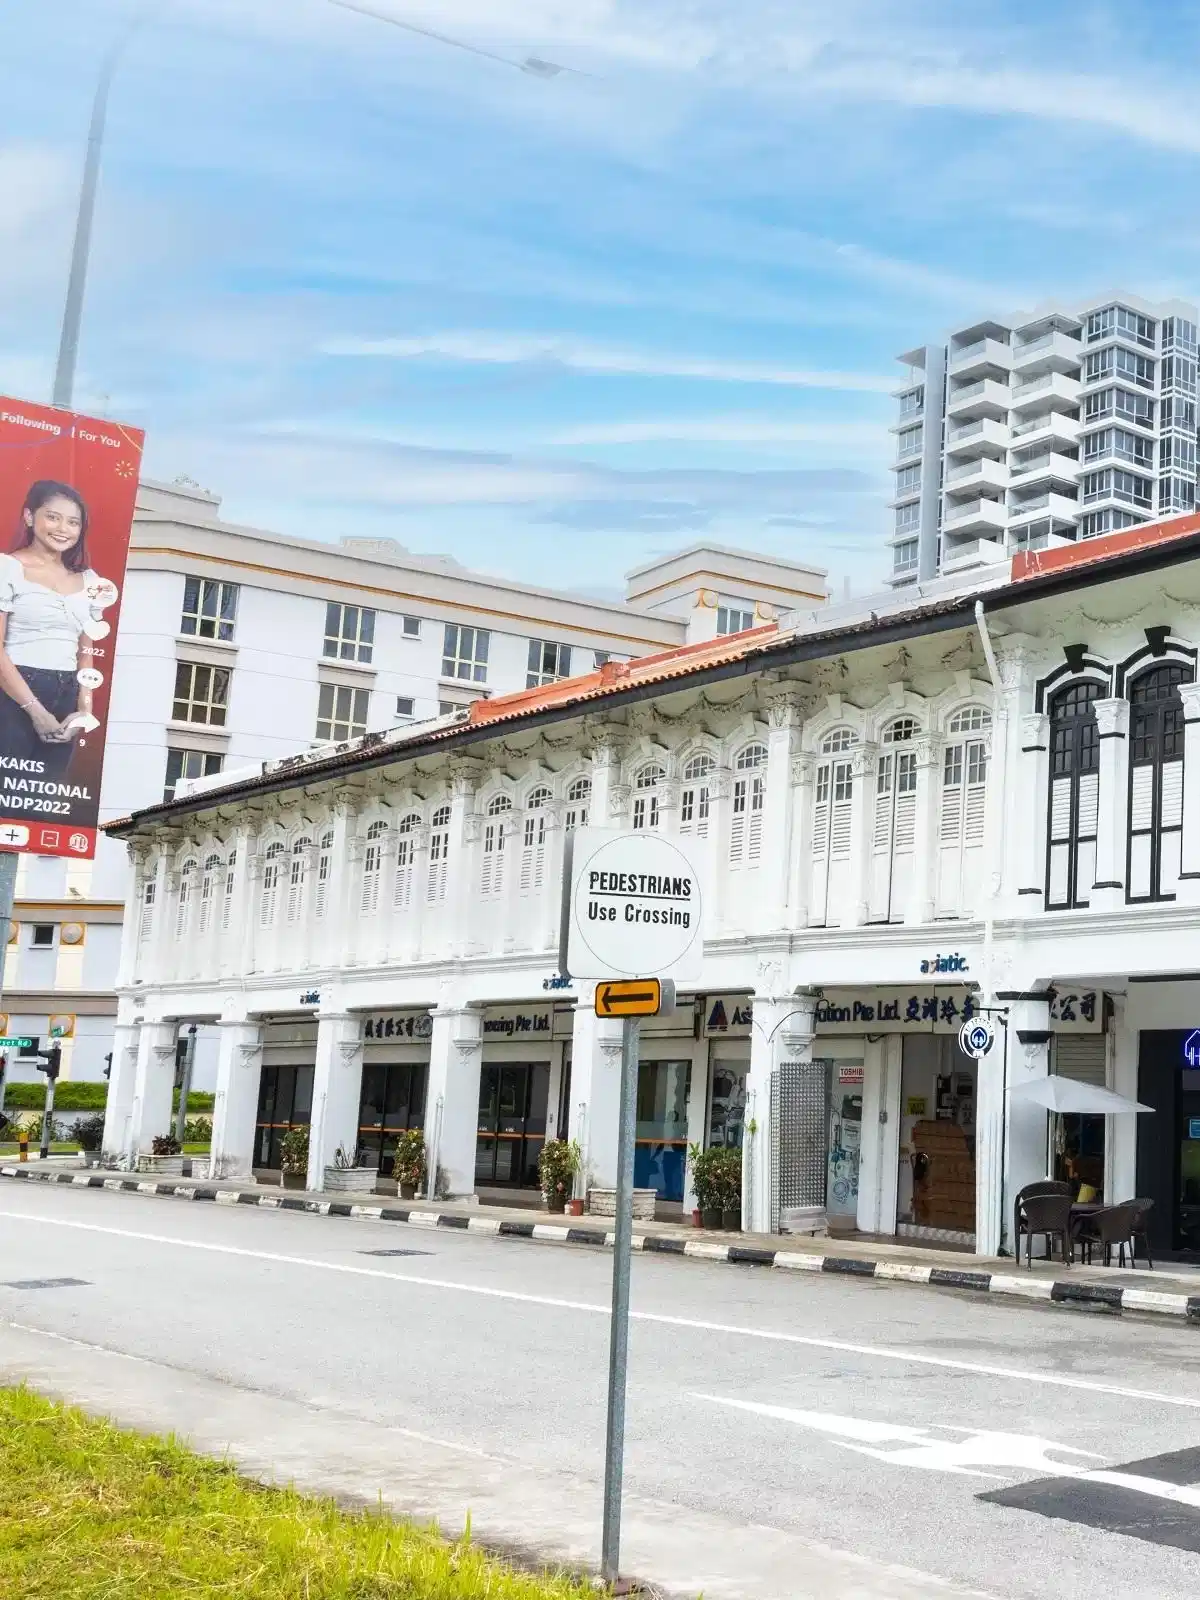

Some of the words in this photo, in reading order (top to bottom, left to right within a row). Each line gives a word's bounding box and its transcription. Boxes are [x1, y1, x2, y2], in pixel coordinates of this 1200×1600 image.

[2, 411, 61, 436] Following
[80, 430, 98, 442] For
[101, 435, 120, 448] You
[82, 647, 105, 657] 2022
[4, 777, 91, 800] NATIONAL
[589, 871, 692, 897] PEDESTRIANS
[588, 901, 617, 921] Use
[625, 903, 691, 929] Crossing
[840, 1068, 864, 1077] TOSHIB
